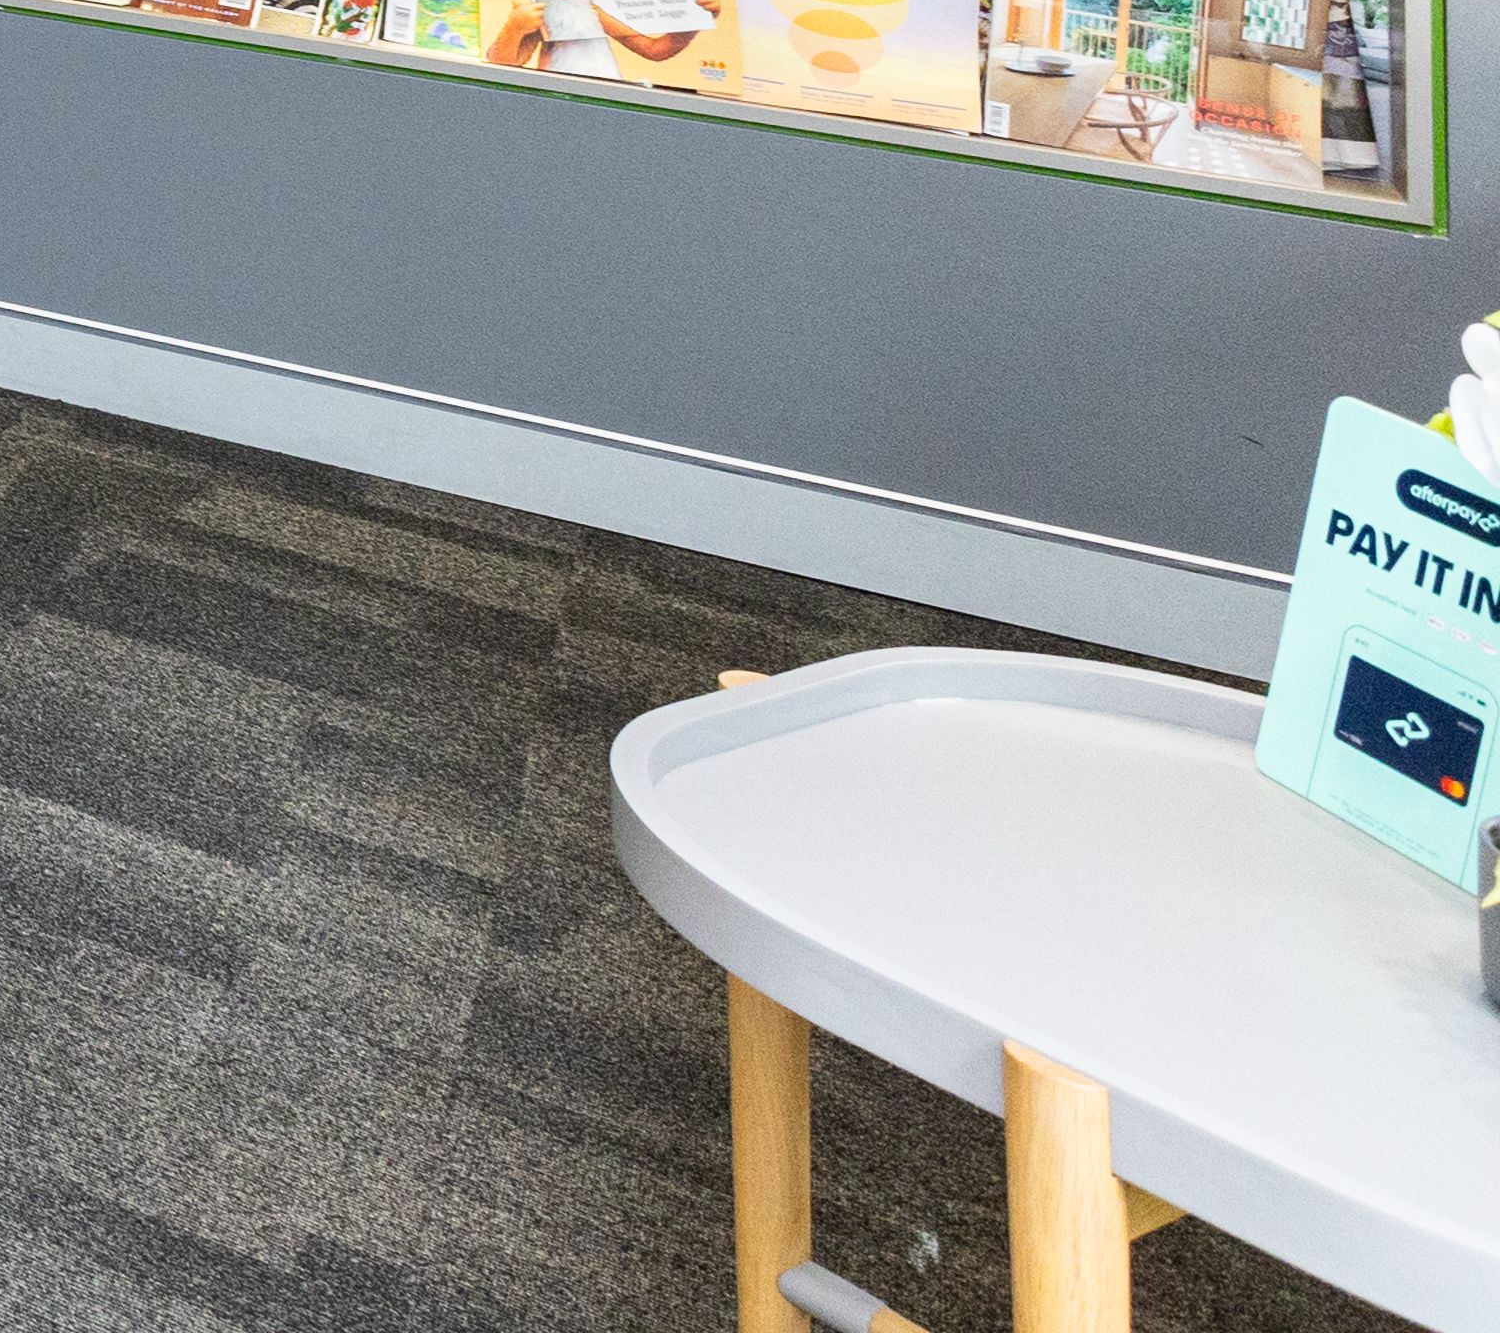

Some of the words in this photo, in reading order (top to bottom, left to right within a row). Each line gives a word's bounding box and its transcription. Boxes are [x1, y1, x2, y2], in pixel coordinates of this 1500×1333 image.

[1409, 484, 1483, 526] afterpay
[1325, 508, 1410, 573] PAY
[1414, 548, 1455, 597] IT
[1458, 569, 1500, 625] IN
